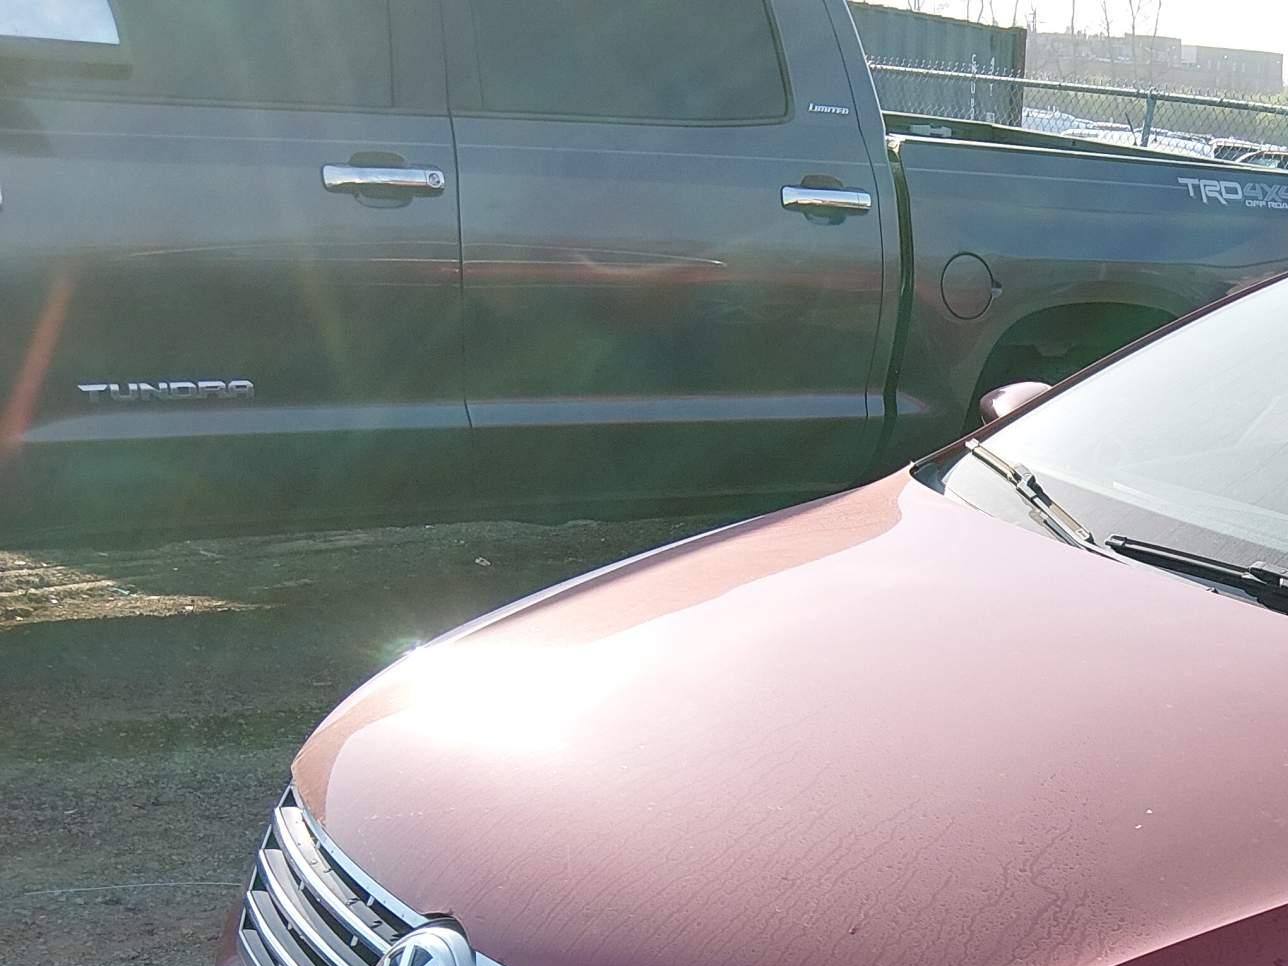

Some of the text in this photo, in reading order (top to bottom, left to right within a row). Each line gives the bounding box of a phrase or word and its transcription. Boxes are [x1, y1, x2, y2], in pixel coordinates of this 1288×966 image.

[1177, 177, 1243, 205] TRD
[1245, 199, 1267, 208] OFF
[77, 379, 255, 401] TUNDRA
